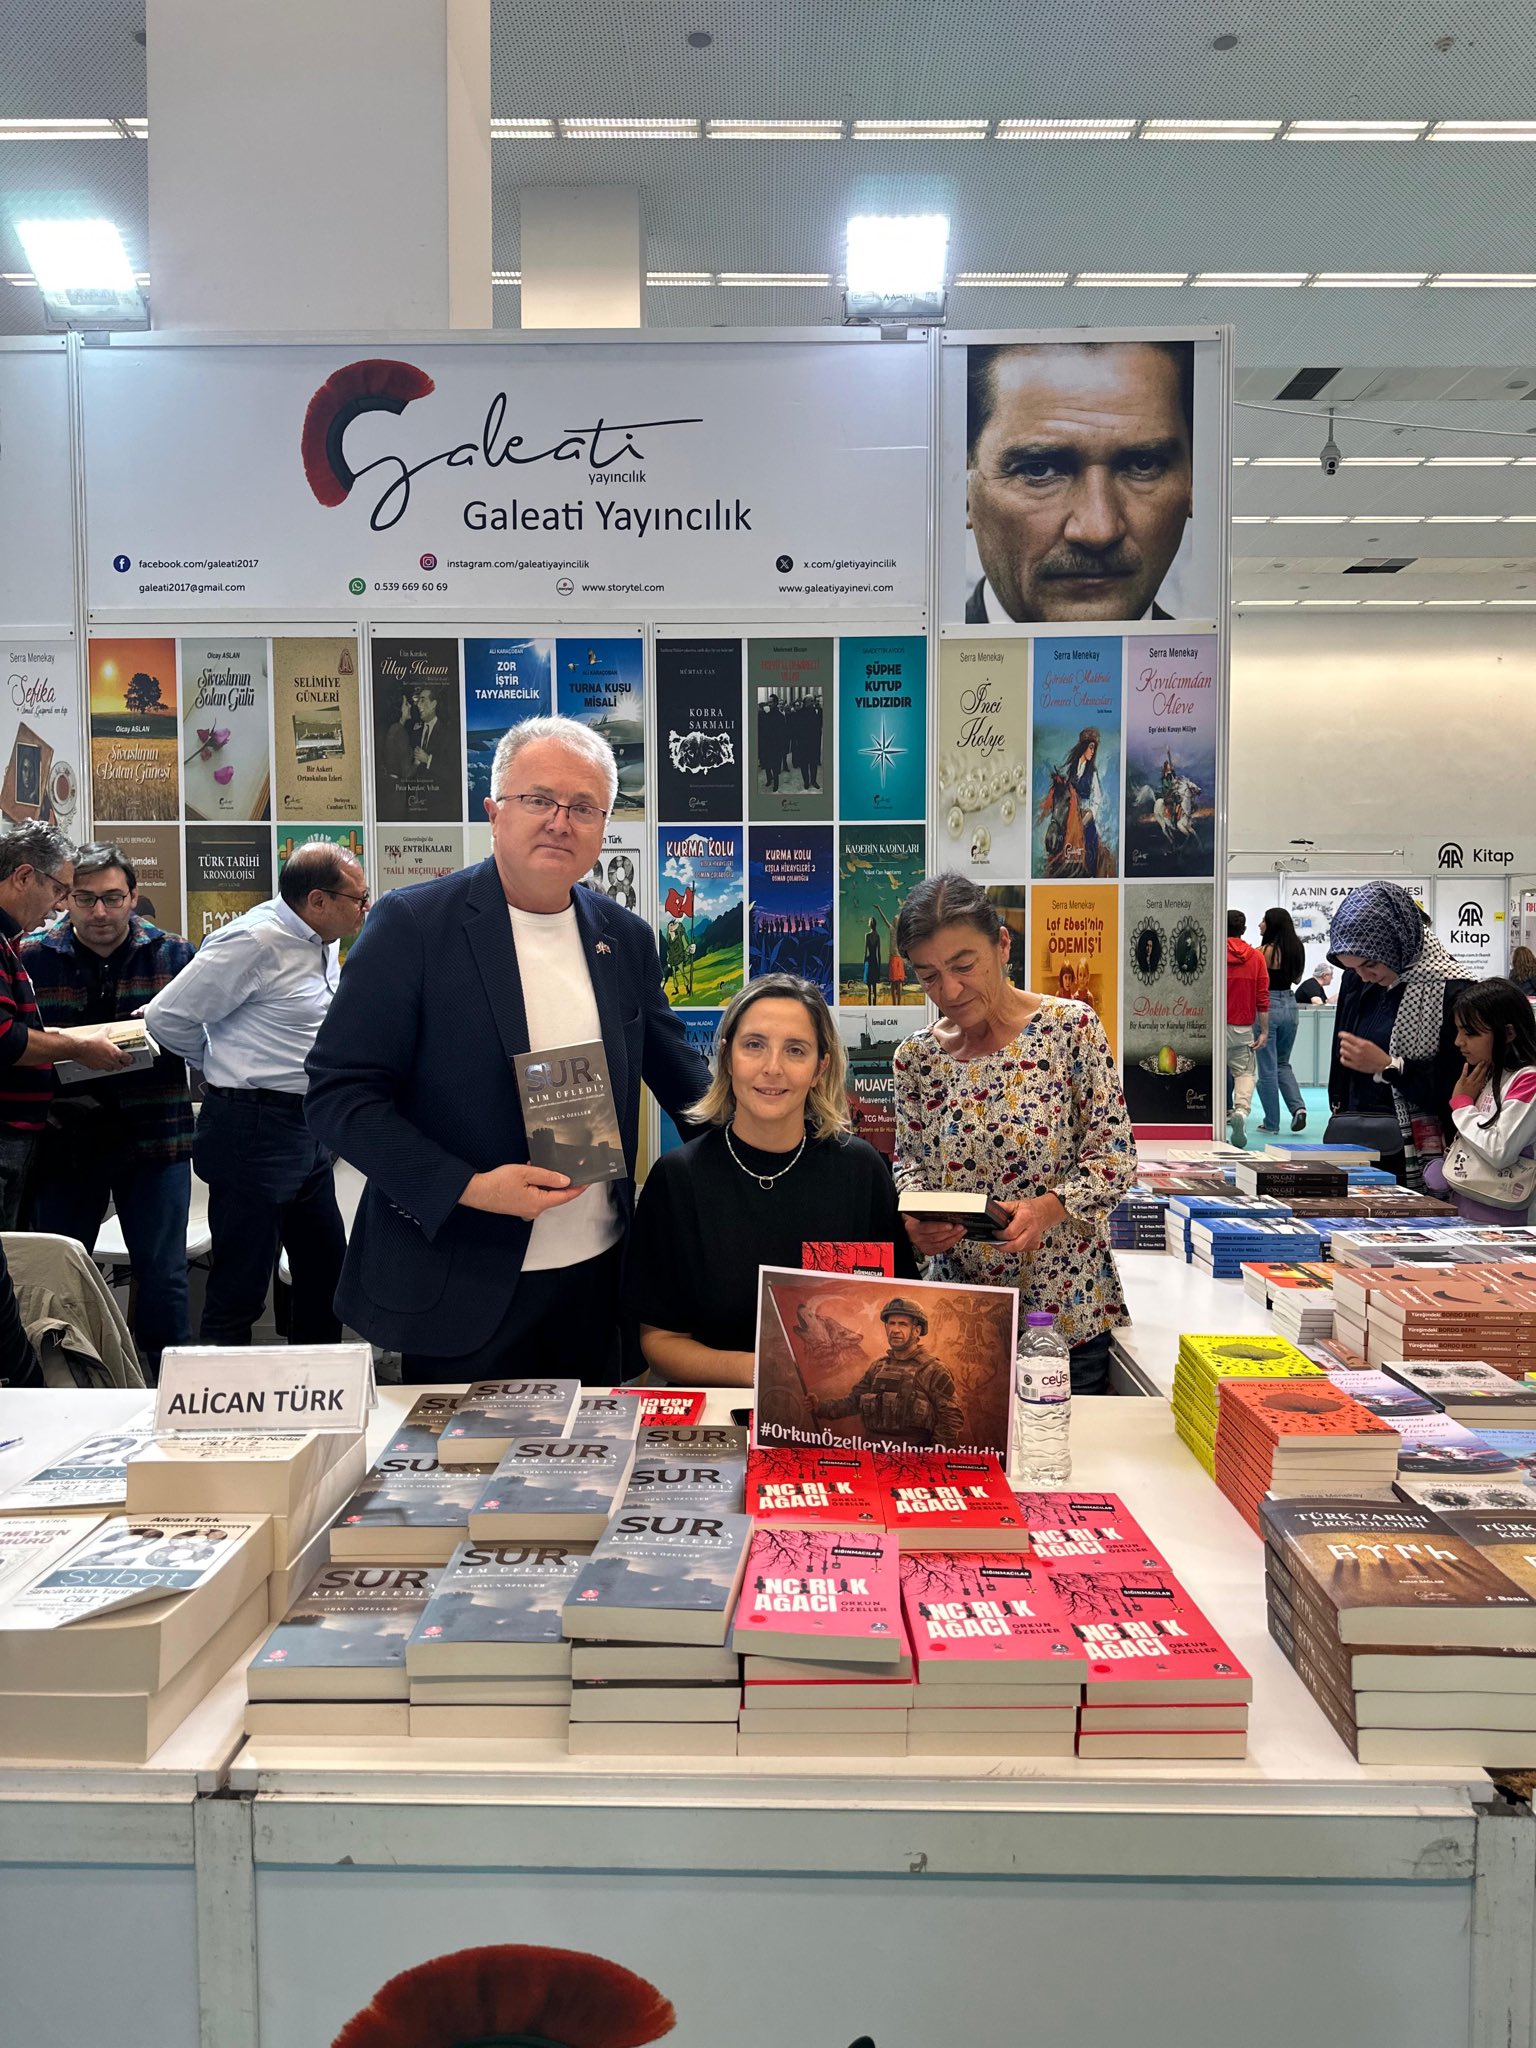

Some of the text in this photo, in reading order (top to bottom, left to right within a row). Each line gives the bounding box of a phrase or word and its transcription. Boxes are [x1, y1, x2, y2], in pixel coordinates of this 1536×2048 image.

[588, 470, 647, 486] yayıncılık
[462, 499, 753, 538] Galeati Yayıncılık
[138, 558, 259, 570] facebook.com/galeati2017
[446, 558, 590, 571] instagram.com/galeatiyayincilik
[803, 558, 898, 570] x.com/gletiyayincilik
[138, 582, 247, 594] galeati2017@gmail.com
[401, 582, 420, 592] 669
[421, 582, 434, 592] 60
[436, 582, 449, 592] 69
[581, 583, 665, 594] www.storytel.com
[778, 583, 894, 595] www.galeatiyayinevi.com
[9, 653, 55, 665] Serra Menekay
[959, 652, 1005, 664] Serra Menekay
[1054, 650, 1100, 662] Serra Menekay
[1149, 648, 1199, 660] Serra Menekay
[497, 661, 517, 671] ZOR
[865, 661, 902, 678] ŞÜPHE
[294, 675, 341, 688] SELİMİYE
[495, 673, 519, 688] İŞTİR
[865, 681, 902, 691] KUTUP
[475, 688, 540, 699] TAYYARECİLİK
[569, 683, 631, 696] TURNA KUŞU
[296, 690, 340, 703] GÜNLERİ
[584, 696, 617, 707] MİSALİ
[855, 697, 912, 708] YILDIZIDIR
[1152, 692, 1194, 716] Aleve
[689, 708, 724, 717] KOBRA
[689, 720, 735, 729] SARMALI
[608, 836, 623, 844] Türk
[403, 844, 453, 853] ENTRİKALARI
[666, 840, 734, 857] KURMA KOLU
[198, 853, 260, 868] TÜRK TARİHİ
[765, 849, 812, 861] KURMA KOLU
[1473, 848, 1514, 867] Kitap
[203, 869, 255, 881] KRONOLOJİSİ
[1052, 900, 1095, 911] Serra Menekay
[1146, 899, 1192, 911] Serra Menekay
[1046, 916, 1060, 931] Laf
[1450, 930, 1490, 948] Kitap
[871, 1018, 898, 1026] İsmail CAN
[528, 1094, 549, 1104] KİM
[167, 1384, 345, 1415] ALİCAN TÜRK
[759, 1494, 829, 1510] AĞACI
[896, 1497, 968, 1514] AĞACI
[1295, 1511, 1431, 1524] TÜRK TARİHİ
[1032, 1540, 1107, 1559] AĞACI
[60, 1569, 184, 1587] Şubat
[754, 1594, 838, 1613] AĞACI
[926, 1618, 1013, 1640] AĞACI
[1082, 1637, 1171, 1661] AĞACI
